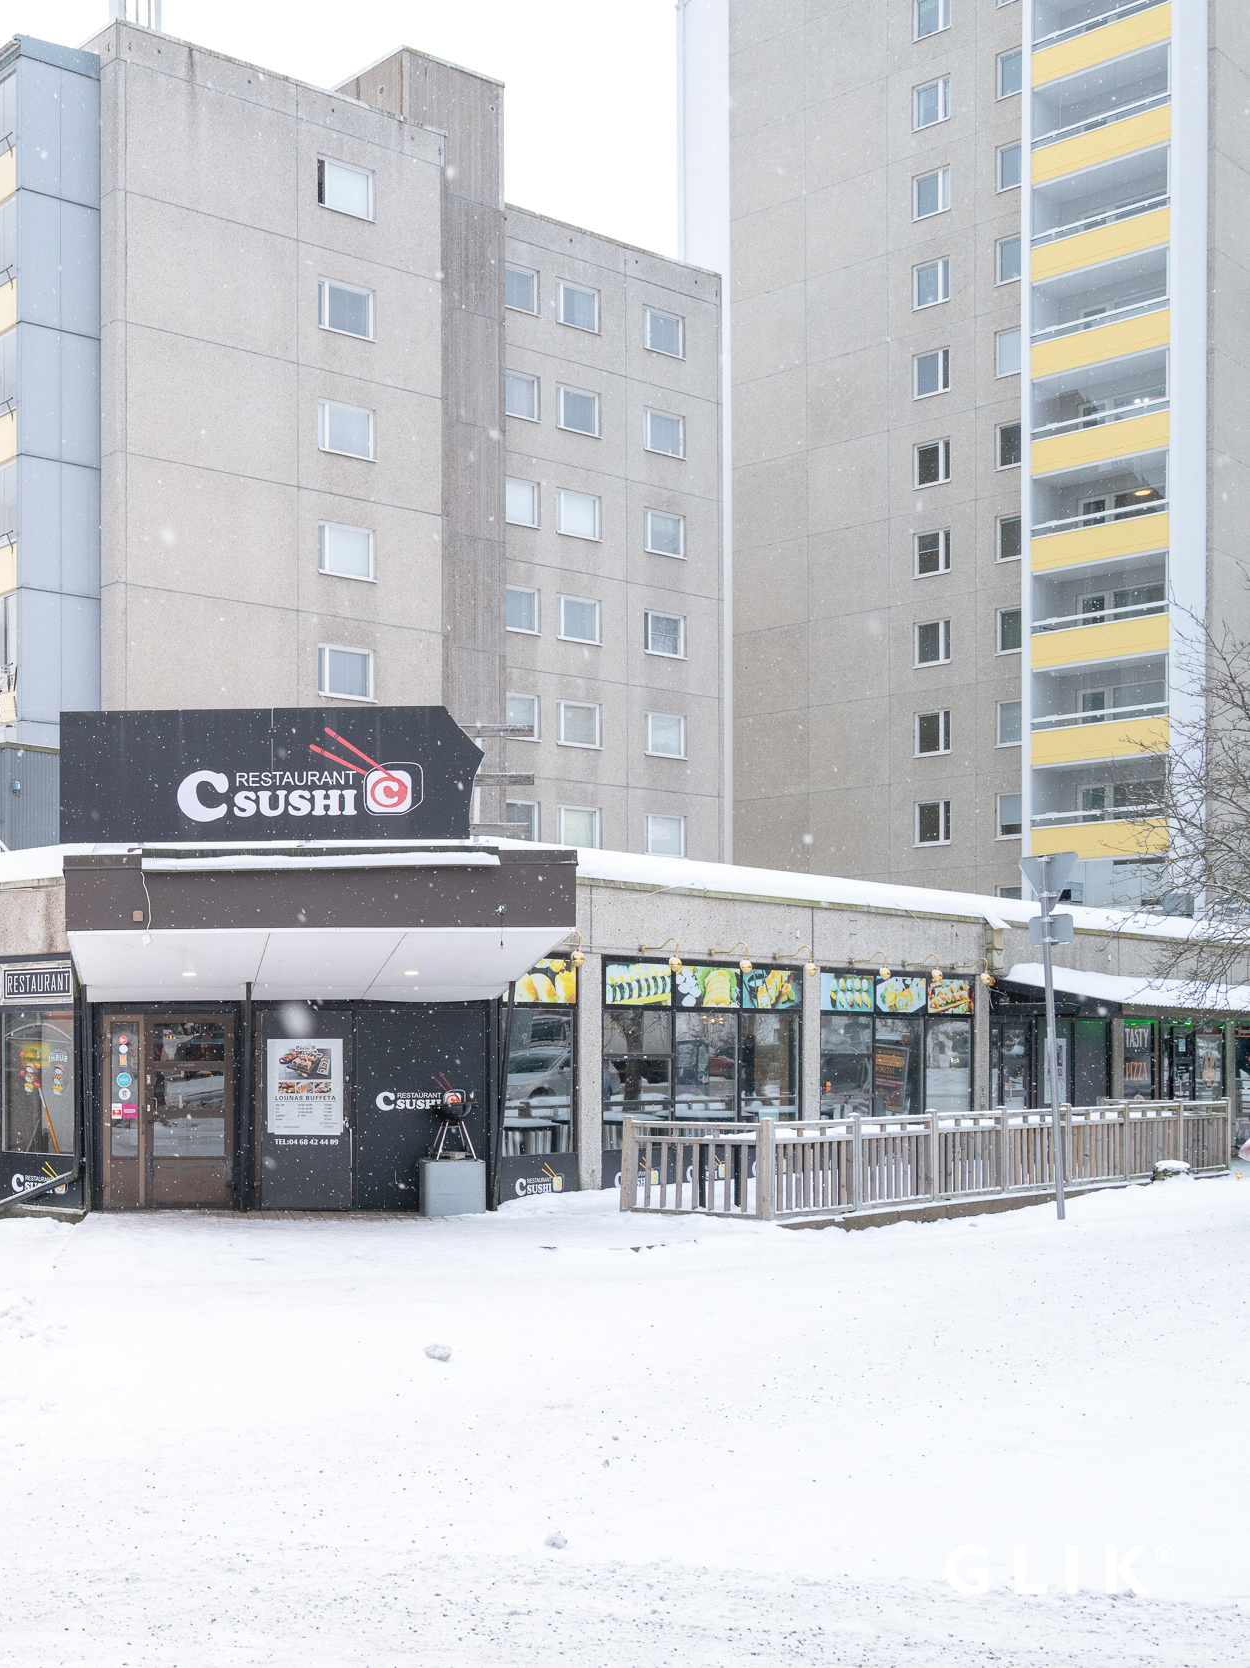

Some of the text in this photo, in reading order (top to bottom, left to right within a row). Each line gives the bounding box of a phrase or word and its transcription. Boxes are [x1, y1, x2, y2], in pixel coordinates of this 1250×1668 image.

[236, 771, 357, 787] RESTAURANT
[177, 770, 358, 822] C SUSHI
[374, 780, 400, 800] C
[7, 973, 70, 993] RESTAURANT
[1124, 1028, 1149, 1048] TASTY
[1125, 1062, 1148, 1081] PIZZA
[526, 1183, 552, 1194] SUSHI
